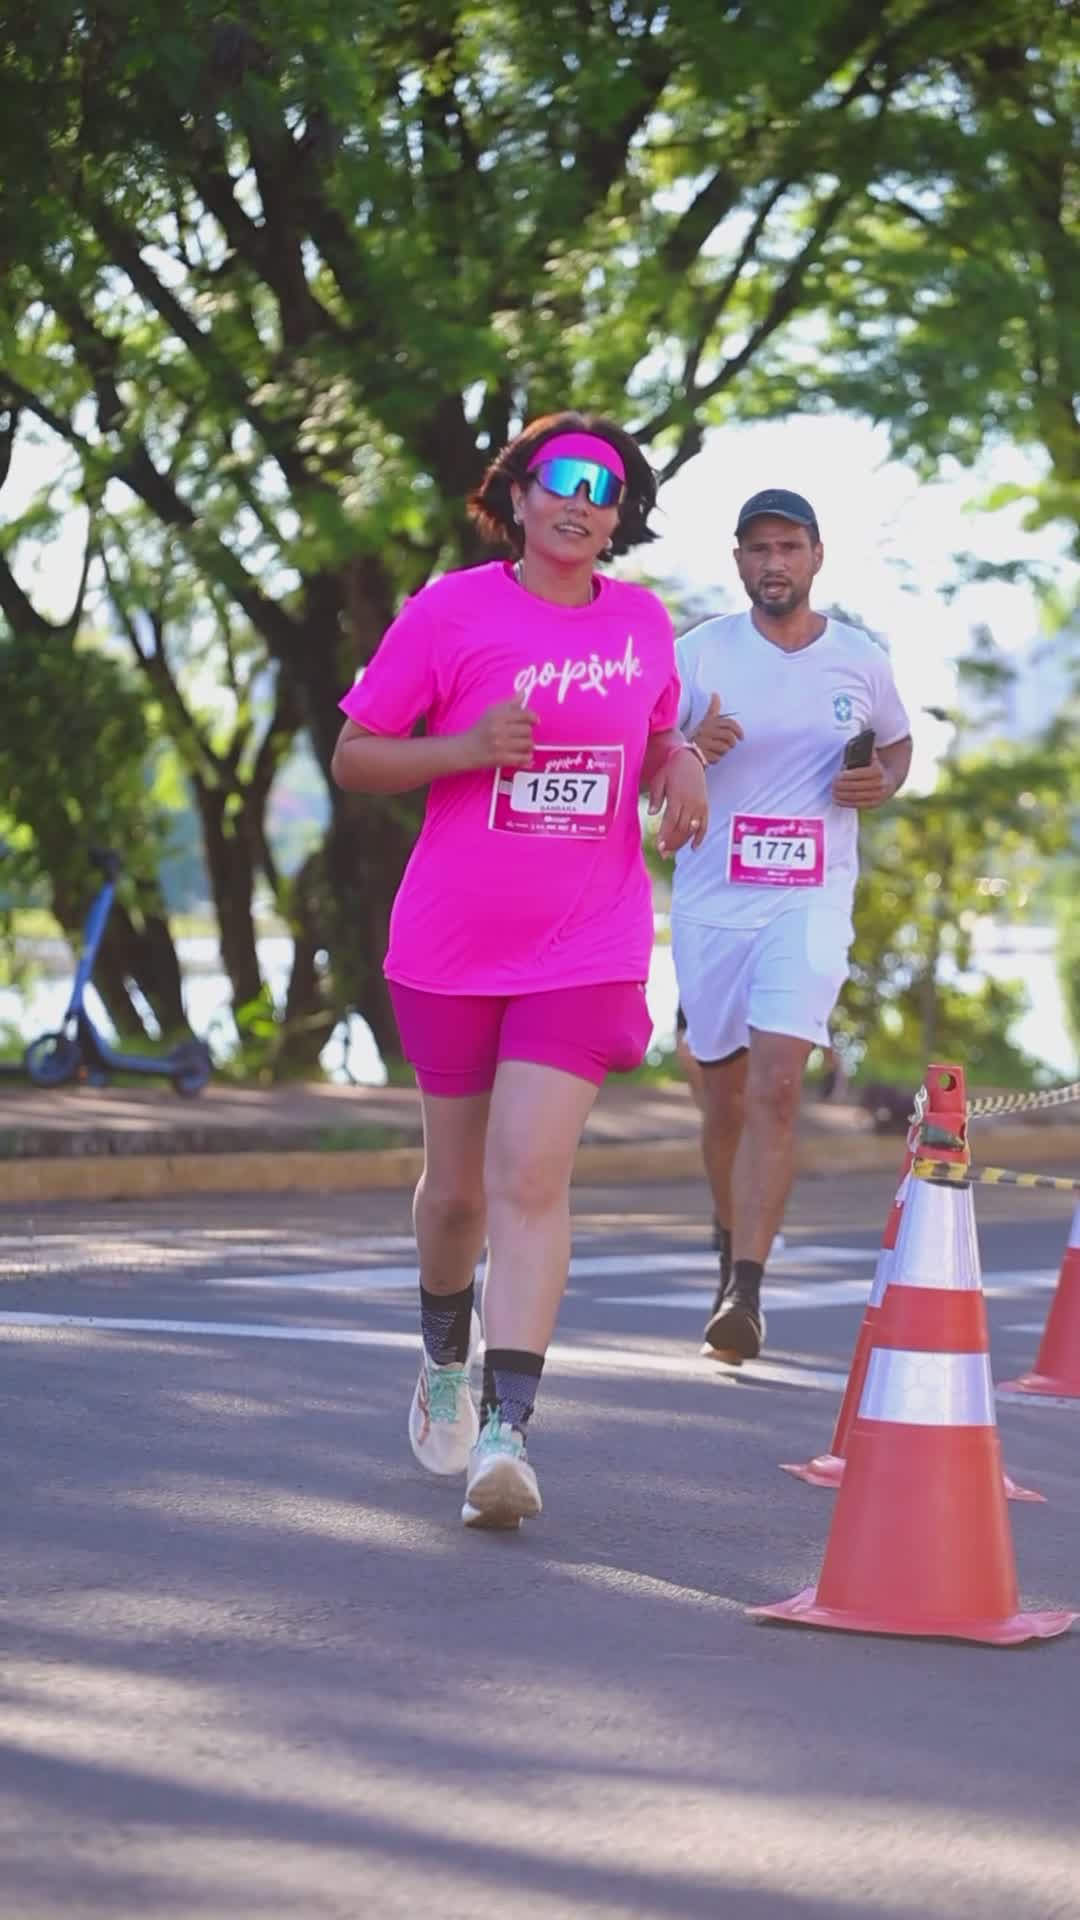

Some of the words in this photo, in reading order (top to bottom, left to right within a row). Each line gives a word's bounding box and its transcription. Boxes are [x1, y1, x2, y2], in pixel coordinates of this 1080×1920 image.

[514, 634, 643, 710] gopink
[527, 778, 598, 804] 1557
[752, 840, 806, 861] 1774
